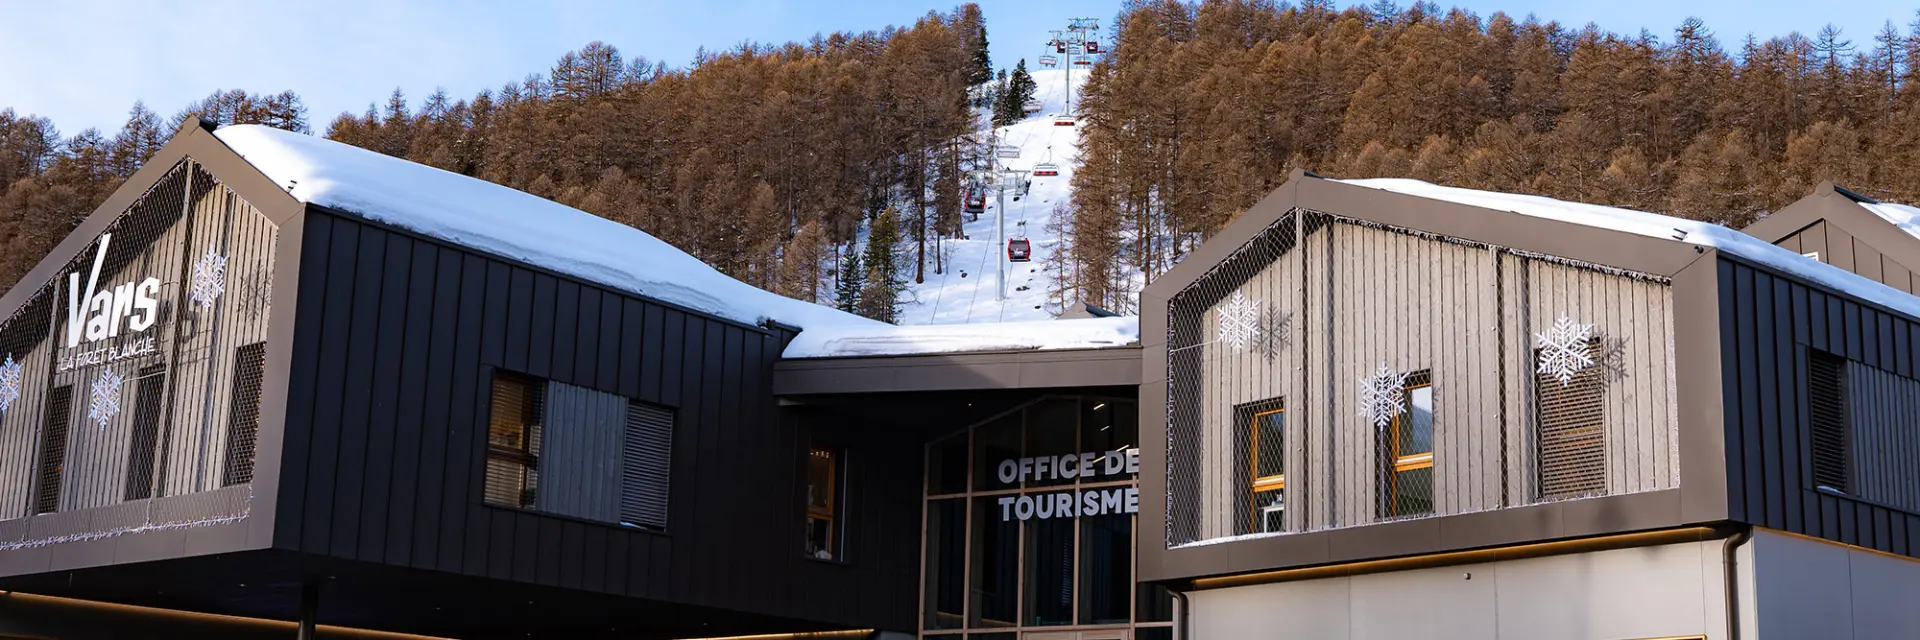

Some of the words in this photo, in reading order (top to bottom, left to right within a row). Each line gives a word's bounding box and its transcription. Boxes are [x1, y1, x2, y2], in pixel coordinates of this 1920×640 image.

[68, 233, 159, 348] Vars
[60, 356, 73, 371] LA
[108, 336, 155, 361] BLANCHE
[998, 452, 1096, 484] OFFICE
[1105, 448, 1139, 475] DE
[998, 488, 1138, 521] TOURISME
